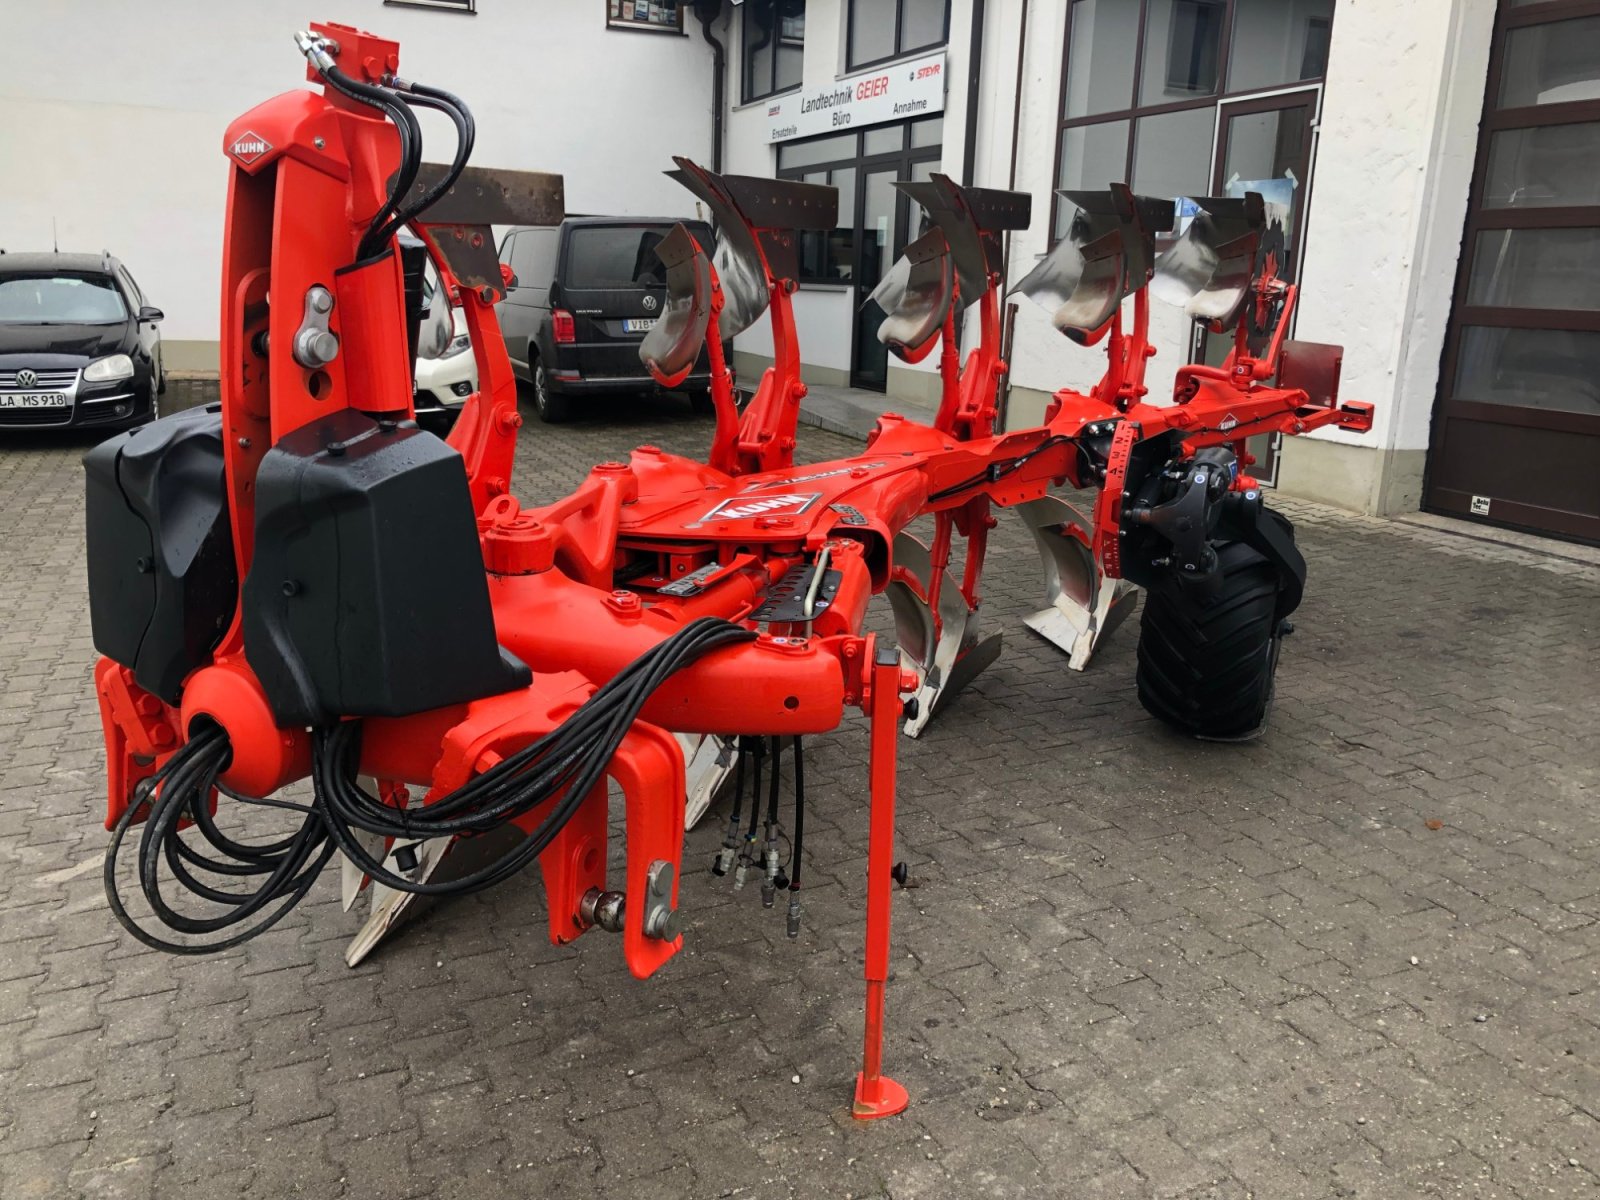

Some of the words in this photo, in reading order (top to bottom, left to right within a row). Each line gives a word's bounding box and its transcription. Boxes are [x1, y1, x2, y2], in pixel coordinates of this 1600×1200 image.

[916, 64, 941, 80] STEYR
[801, 86, 853, 114] Landtechnik
[856, 76, 889, 101] GEIER
[893, 99, 927, 115] Annahme
[832, 111, 851, 127] Büro
[234, 142, 265, 154] KUHN
[0, 396, 15, 406] LA
[22, 395, 39, 406] MS
[41, 394, 64, 405] 918
[715, 494, 811, 519] KUHN
